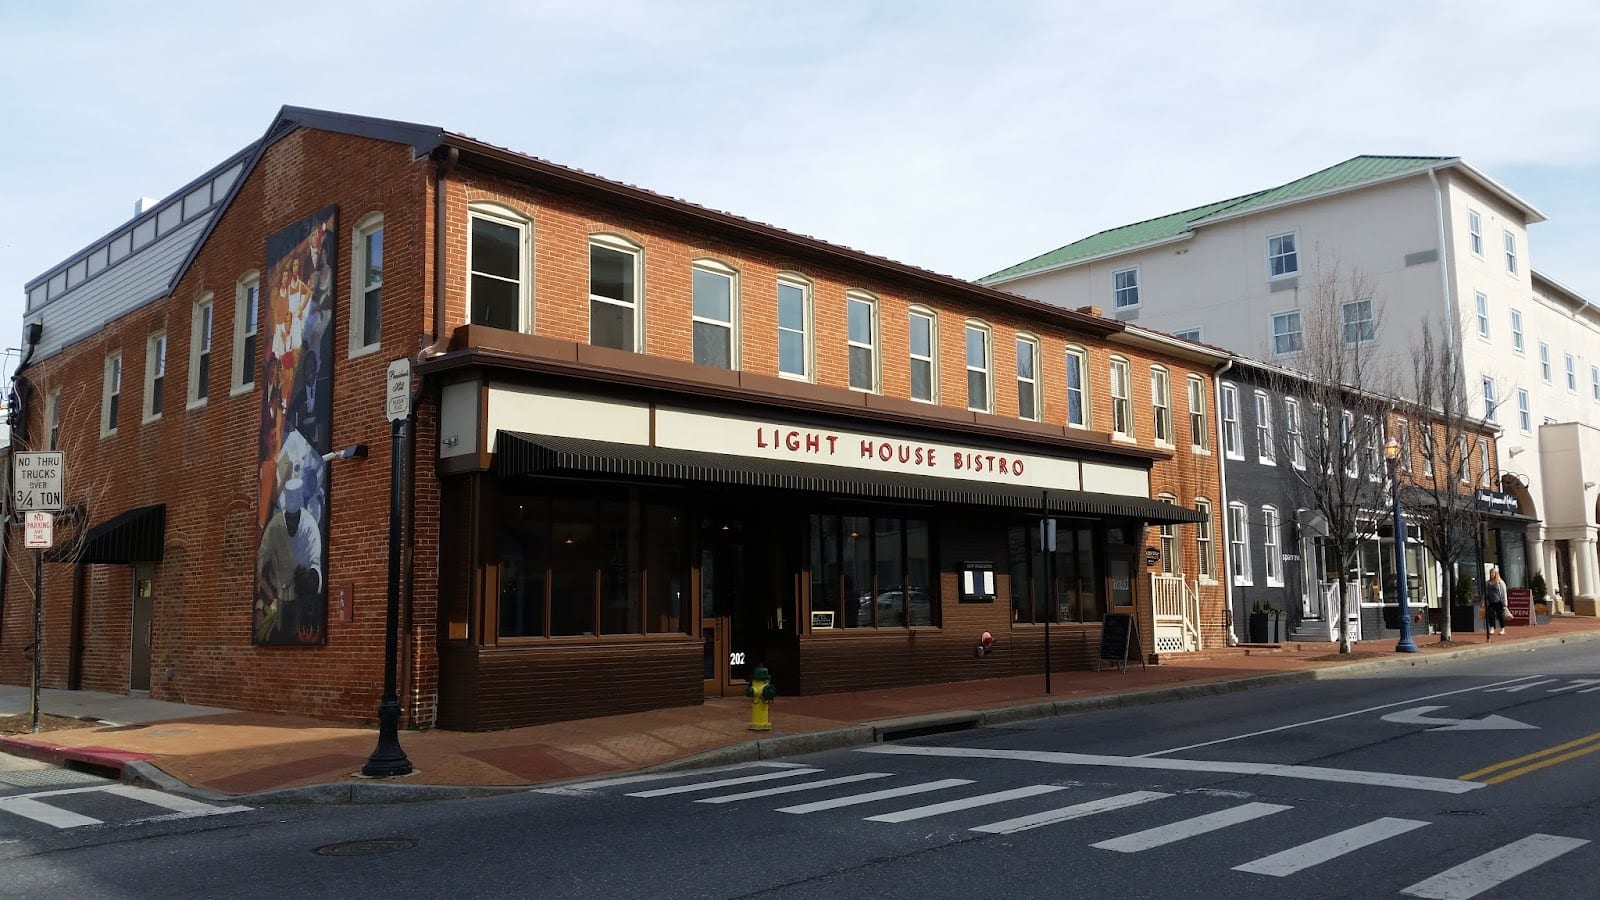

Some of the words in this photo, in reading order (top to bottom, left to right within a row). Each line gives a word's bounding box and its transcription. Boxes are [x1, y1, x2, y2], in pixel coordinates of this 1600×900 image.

[757, 427, 838, 456] LIGHT
[860, 439, 936, 467] HOUSE
[953, 451, 1024, 476] BISTRO
[18, 458, 30, 467] NO
[38, 457, 60, 466] THRU
[22, 470, 56, 479] TRUCKS
[40, 492, 60, 505] TON
[730, 652, 746, 665] 202
